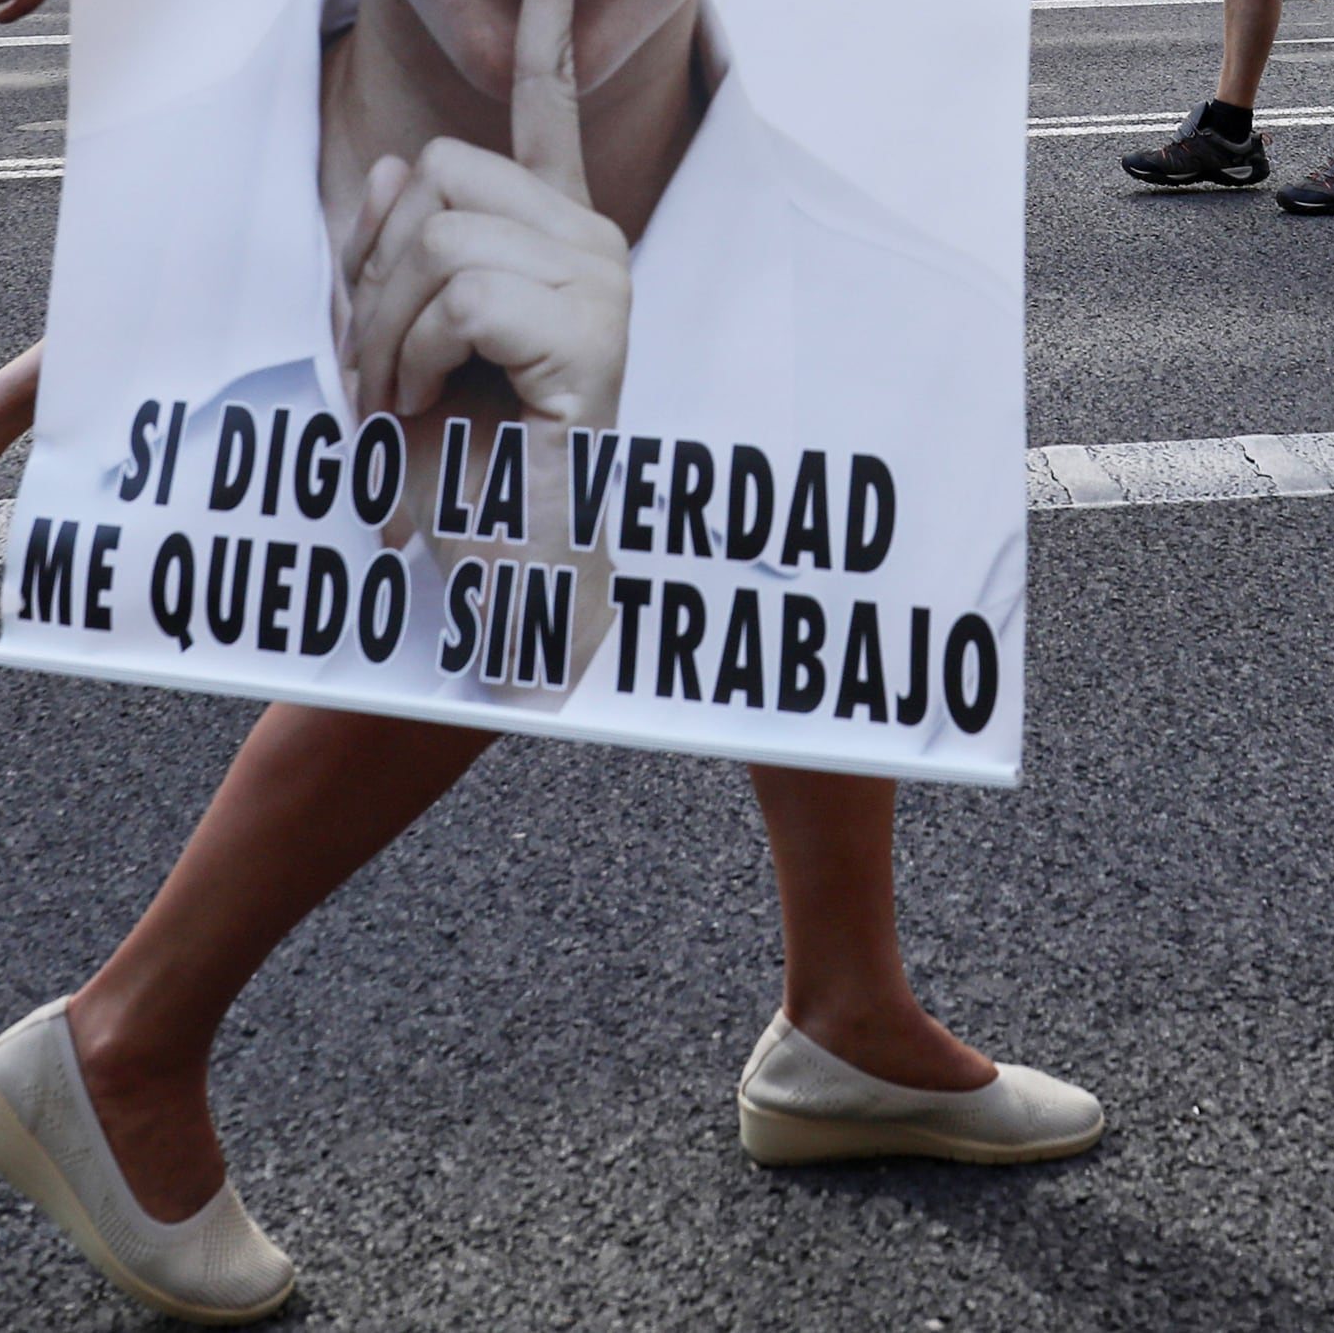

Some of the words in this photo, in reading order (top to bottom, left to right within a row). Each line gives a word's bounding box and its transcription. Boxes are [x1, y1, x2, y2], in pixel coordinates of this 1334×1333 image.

[117, 398, 186, 508] SI
[208, 400, 406, 527] DIGO
[435, 418, 527, 542] LA
[569, 428, 898, 575] VERDAD
[19, 517, 122, 631] ME
[149, 532, 410, 664] QUEDO
[439, 561, 578, 688] SIN
[610, 575, 999, 735] TRABAJO
